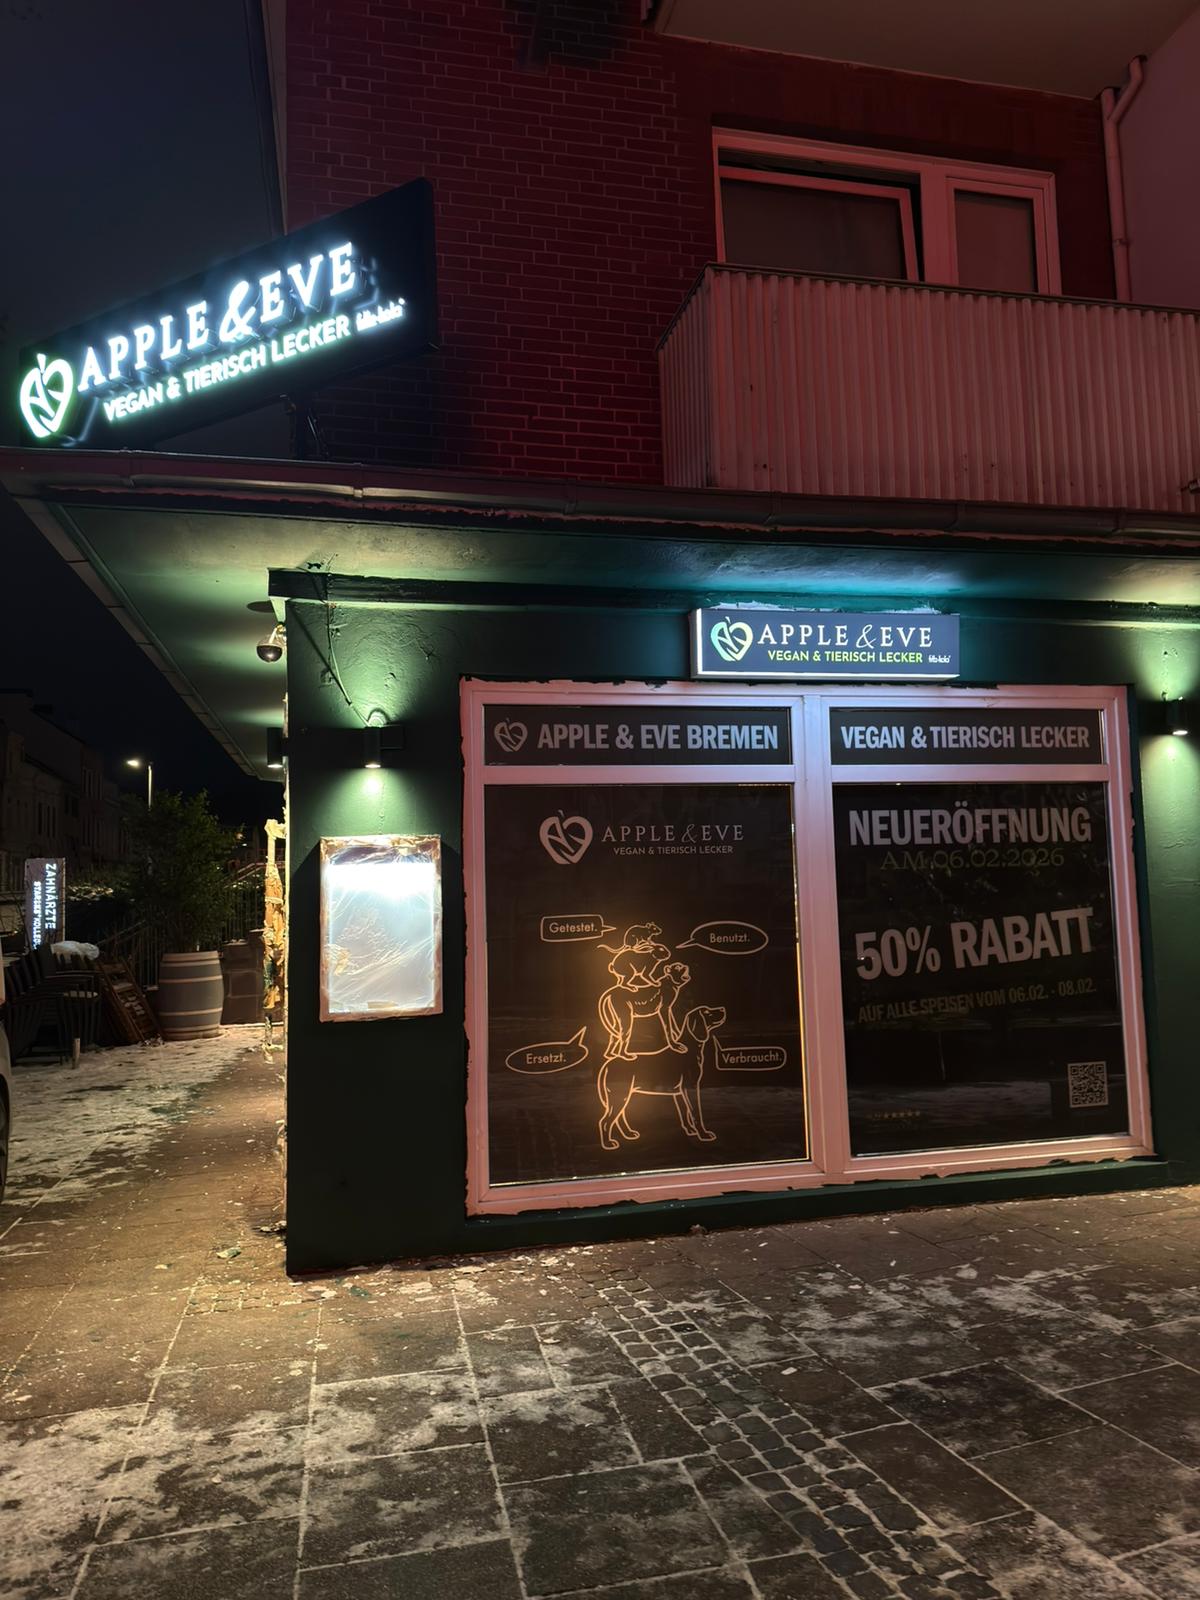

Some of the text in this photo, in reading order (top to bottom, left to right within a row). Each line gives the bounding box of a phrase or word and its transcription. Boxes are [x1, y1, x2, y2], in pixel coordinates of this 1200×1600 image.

[77, 301, 209, 392] APPLE
[219, 281, 257, 342] &
[259, 242, 356, 323] EVE
[103, 382, 165, 422] VEGAN
[166, 376, 181, 398] &
[183, 345, 266, 395] TIERISCH
[272, 314, 351, 363] LECKER
[757, 623, 933, 649] APPLE & EVE
[768, 650, 809, 662] VEGAN
[812, 650, 822, 662] &
[824, 650, 875, 663] TIERISCH
[879, 651, 923, 663] LECKER
[537, 724, 778, 749] APPLE & EVE BREMEN
[840, 725, 1090, 749] VEGAN & TIERISCH LECKER
[602, 824, 744, 843] APPLE & EVE
[849, 800, 1092, 846] NEUERÖFFNUNG
[613, 845, 734, 856] VEGAN & TIERISCH LECKER
[880, 848, 1065, 870] AM 06.02.2026
[45, 863, 57, 930] ZAHNÄRZTE
[549, 921, 598, 934] Getestet.
[709, 931, 751, 944] Benutzt.
[855, 907, 1094, 980] 50% RABATT
[858, 1004, 885, 1024] AUF
[886, 999, 920, 1018] ALLE
[920, 993, 974, 1014] SPEISEN
[976, 988, 1005, 1008] VOM
[526, 1052, 567, 1065] Ersetzt.
[722, 1050, 783, 1064] Verbraucht.
